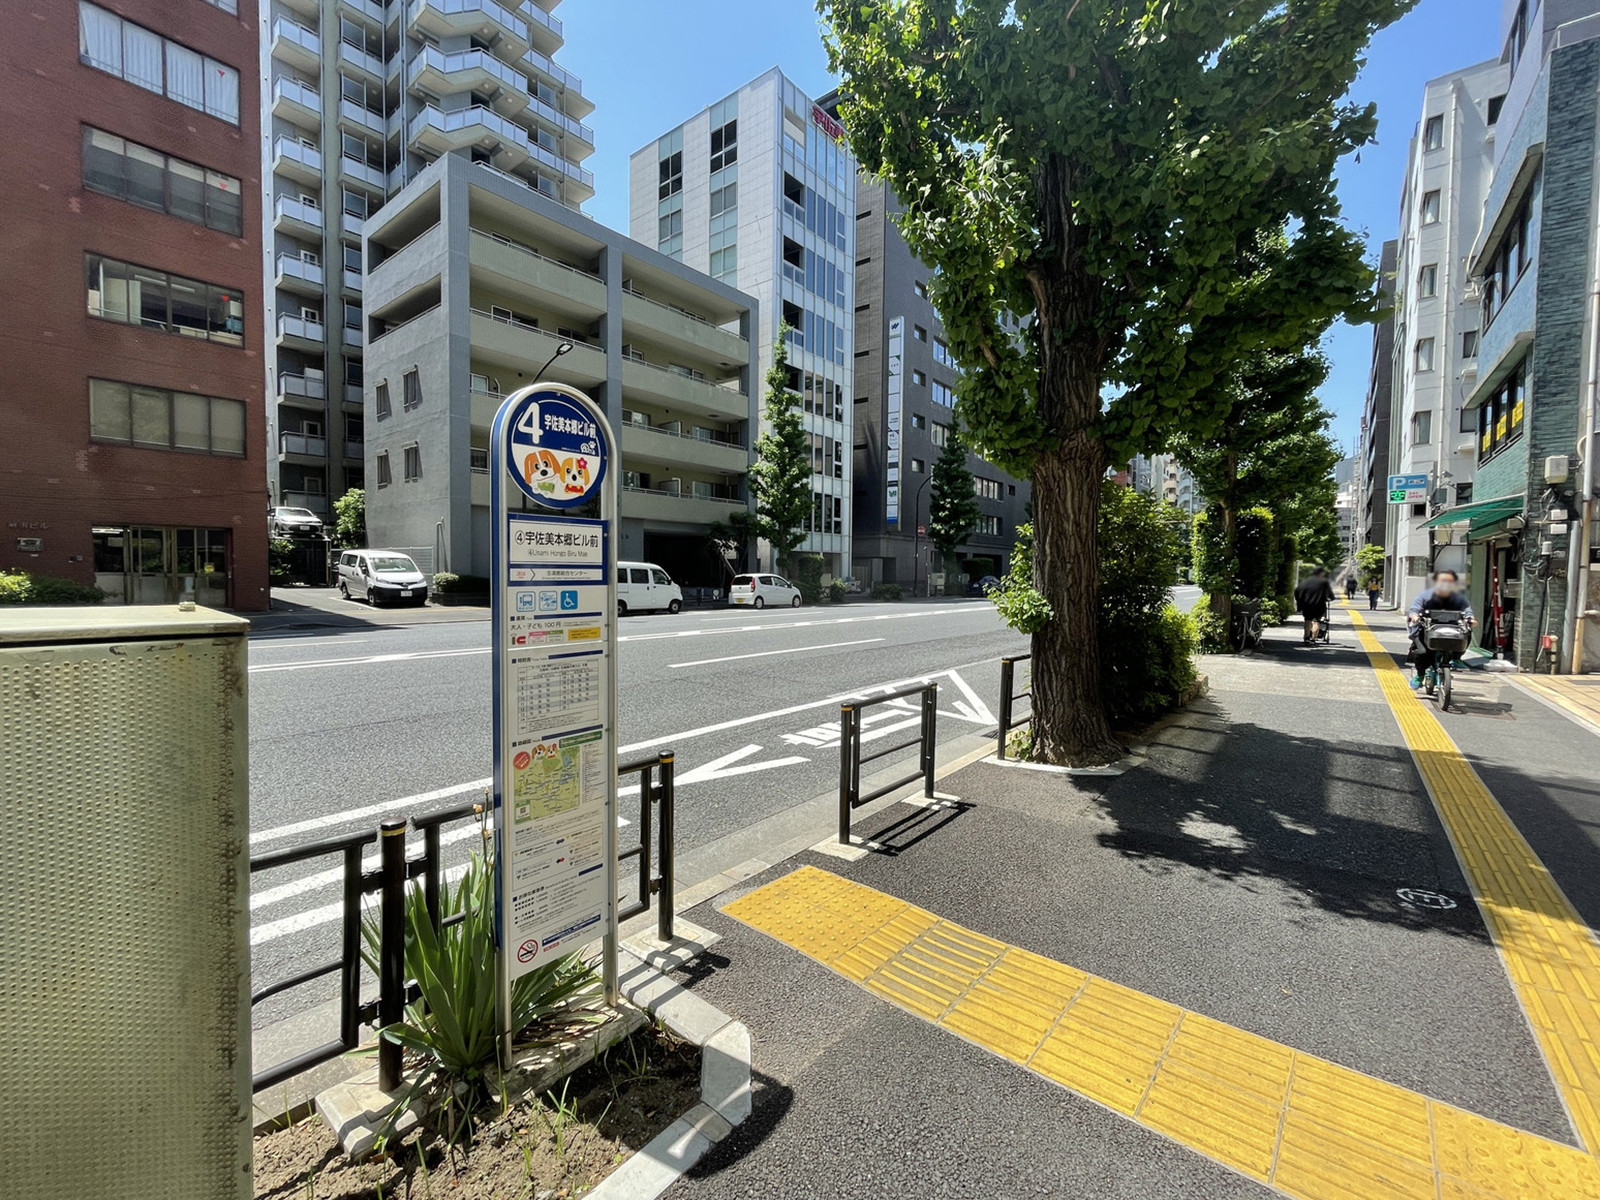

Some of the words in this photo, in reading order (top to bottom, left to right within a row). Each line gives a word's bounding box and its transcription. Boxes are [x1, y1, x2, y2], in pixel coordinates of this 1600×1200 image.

[517, 402, 544, 444] 4
[544, 414, 596, 438] 宇佐美本郷ビル前
[1392, 477, 1407, 490] P
[515, 530, 599, 548] ④宇佐美本郷ビル前
